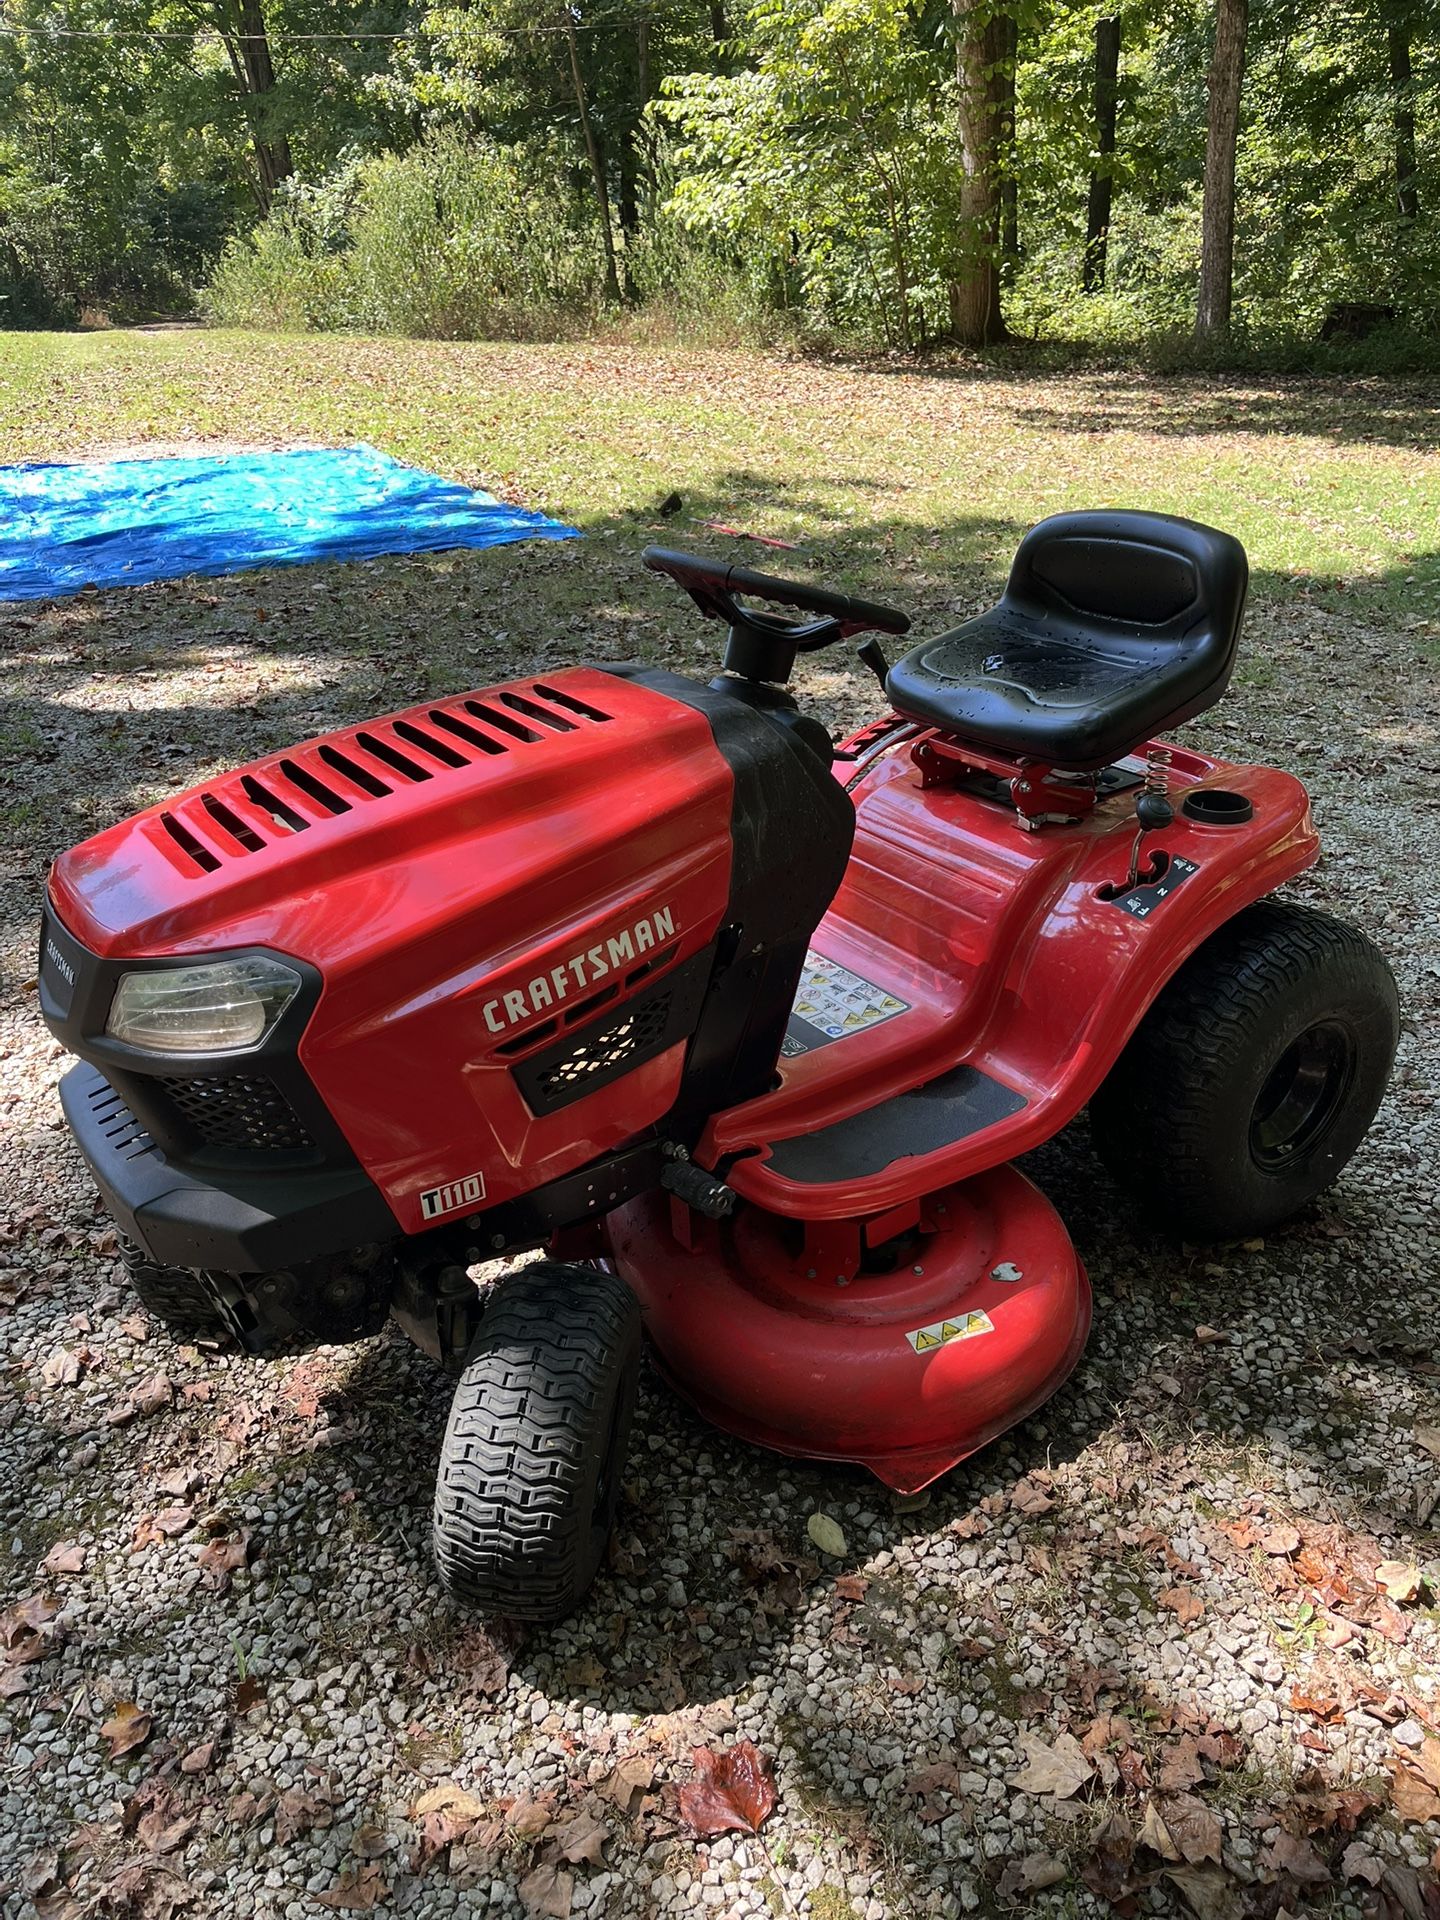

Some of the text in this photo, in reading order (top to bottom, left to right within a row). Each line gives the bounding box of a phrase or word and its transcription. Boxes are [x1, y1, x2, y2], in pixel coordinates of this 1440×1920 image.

[1185, 865, 1195, 873] R
[1156, 887, 1169, 897] N
[1137, 906, 1150, 916] F
[482, 905, 676, 1033] CRAFTSMAN
[422, 1177, 480, 1215] T110
